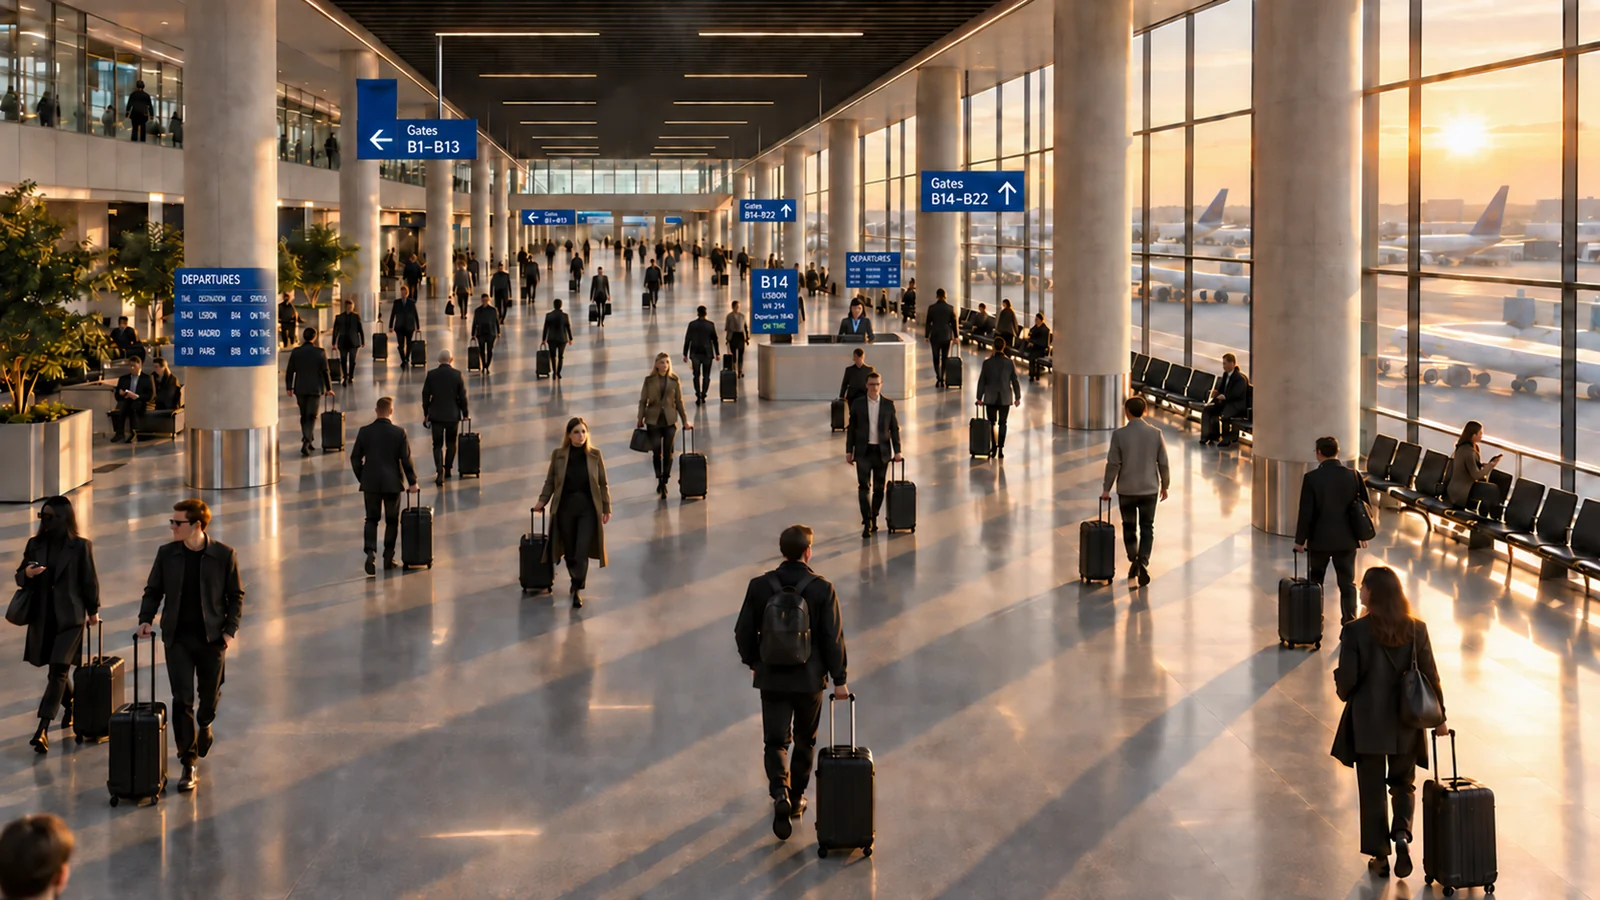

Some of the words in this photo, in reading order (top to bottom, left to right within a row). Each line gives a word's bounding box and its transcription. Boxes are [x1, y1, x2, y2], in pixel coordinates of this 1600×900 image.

[407, 124, 438, 135] Gates
[931, 178, 964, 189] Gates
[182, 274, 240, 284] DEPARTURES
[761, 276, 788, 288] B14
[198, 329, 220, 337] MADRID
[199, 347, 215, 355] PARIS
